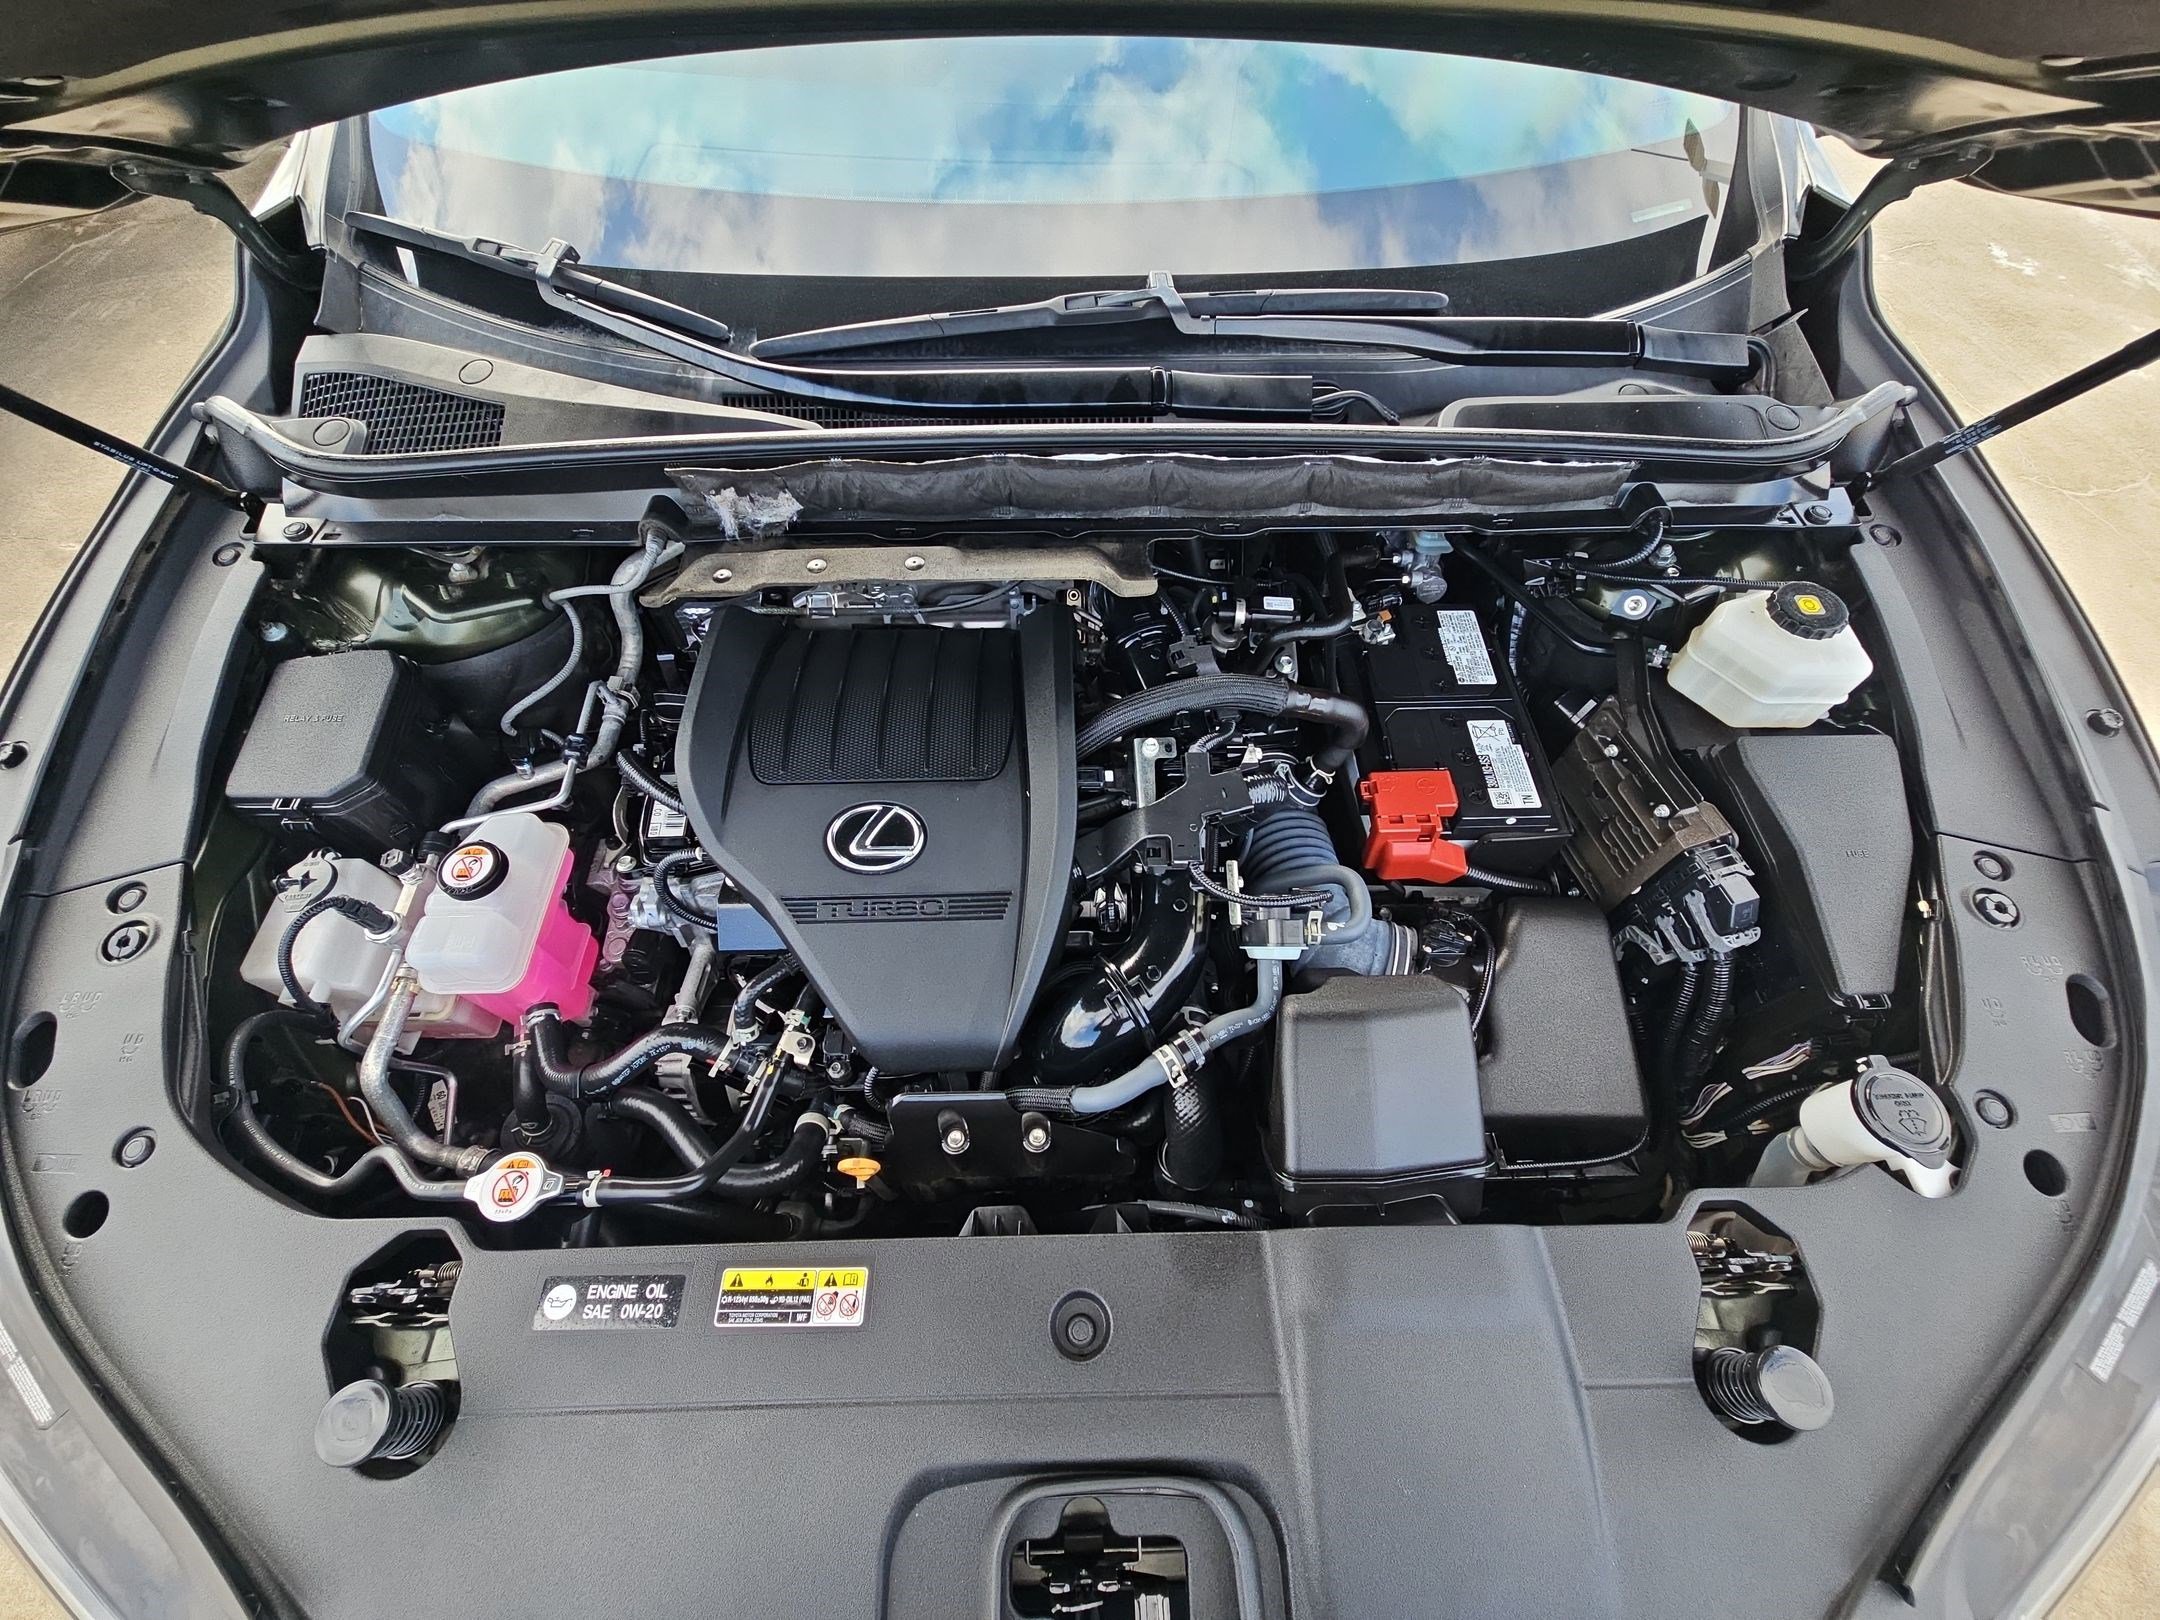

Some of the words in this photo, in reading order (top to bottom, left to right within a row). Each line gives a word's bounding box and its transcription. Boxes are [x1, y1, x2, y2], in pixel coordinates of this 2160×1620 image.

[93, 441, 136, 462] STABILUS
[283, 714, 312, 723] RELAY
[321, 714, 345, 723] FUSE
[1520, 794, 1535, 805] TN
[819, 900, 946, 918] TURBO
[587, 1284, 639, 1300] ENGINE
[645, 1283, 668, 1299] OIL
[582, 1304, 613, 1319] SAE
[620, 1303, 664, 1319] 0W-20
[796, 1313, 808, 1322] WF
